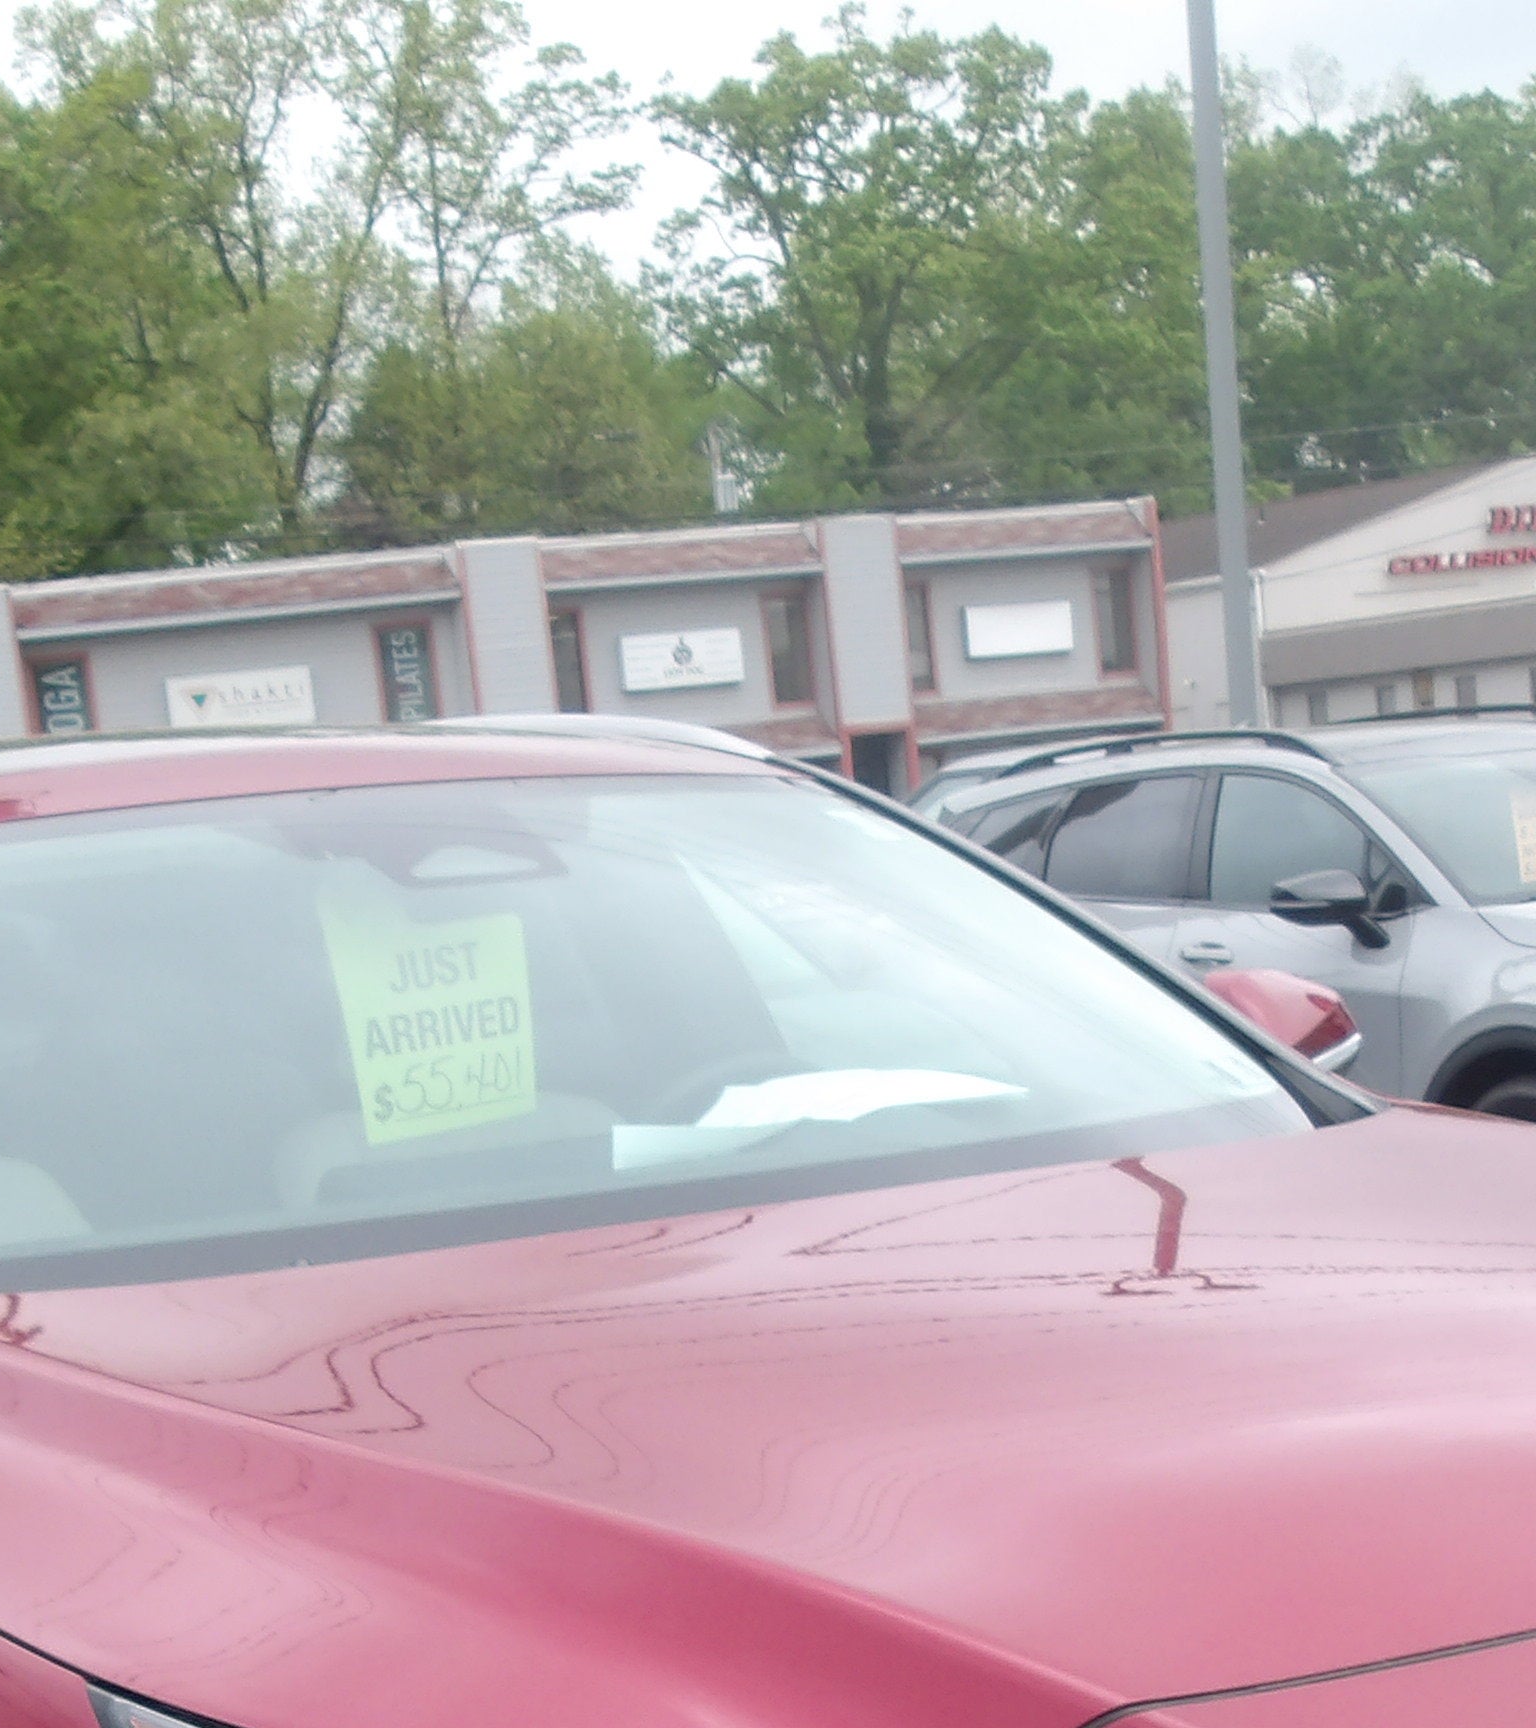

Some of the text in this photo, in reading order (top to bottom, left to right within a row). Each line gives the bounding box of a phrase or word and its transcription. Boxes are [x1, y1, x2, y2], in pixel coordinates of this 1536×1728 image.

[41, 665, 84, 733] OGA
[390, 629, 427, 721] PILATES
[389, 941, 478, 995] JUST
[365, 996, 521, 1059] ARRIVED
